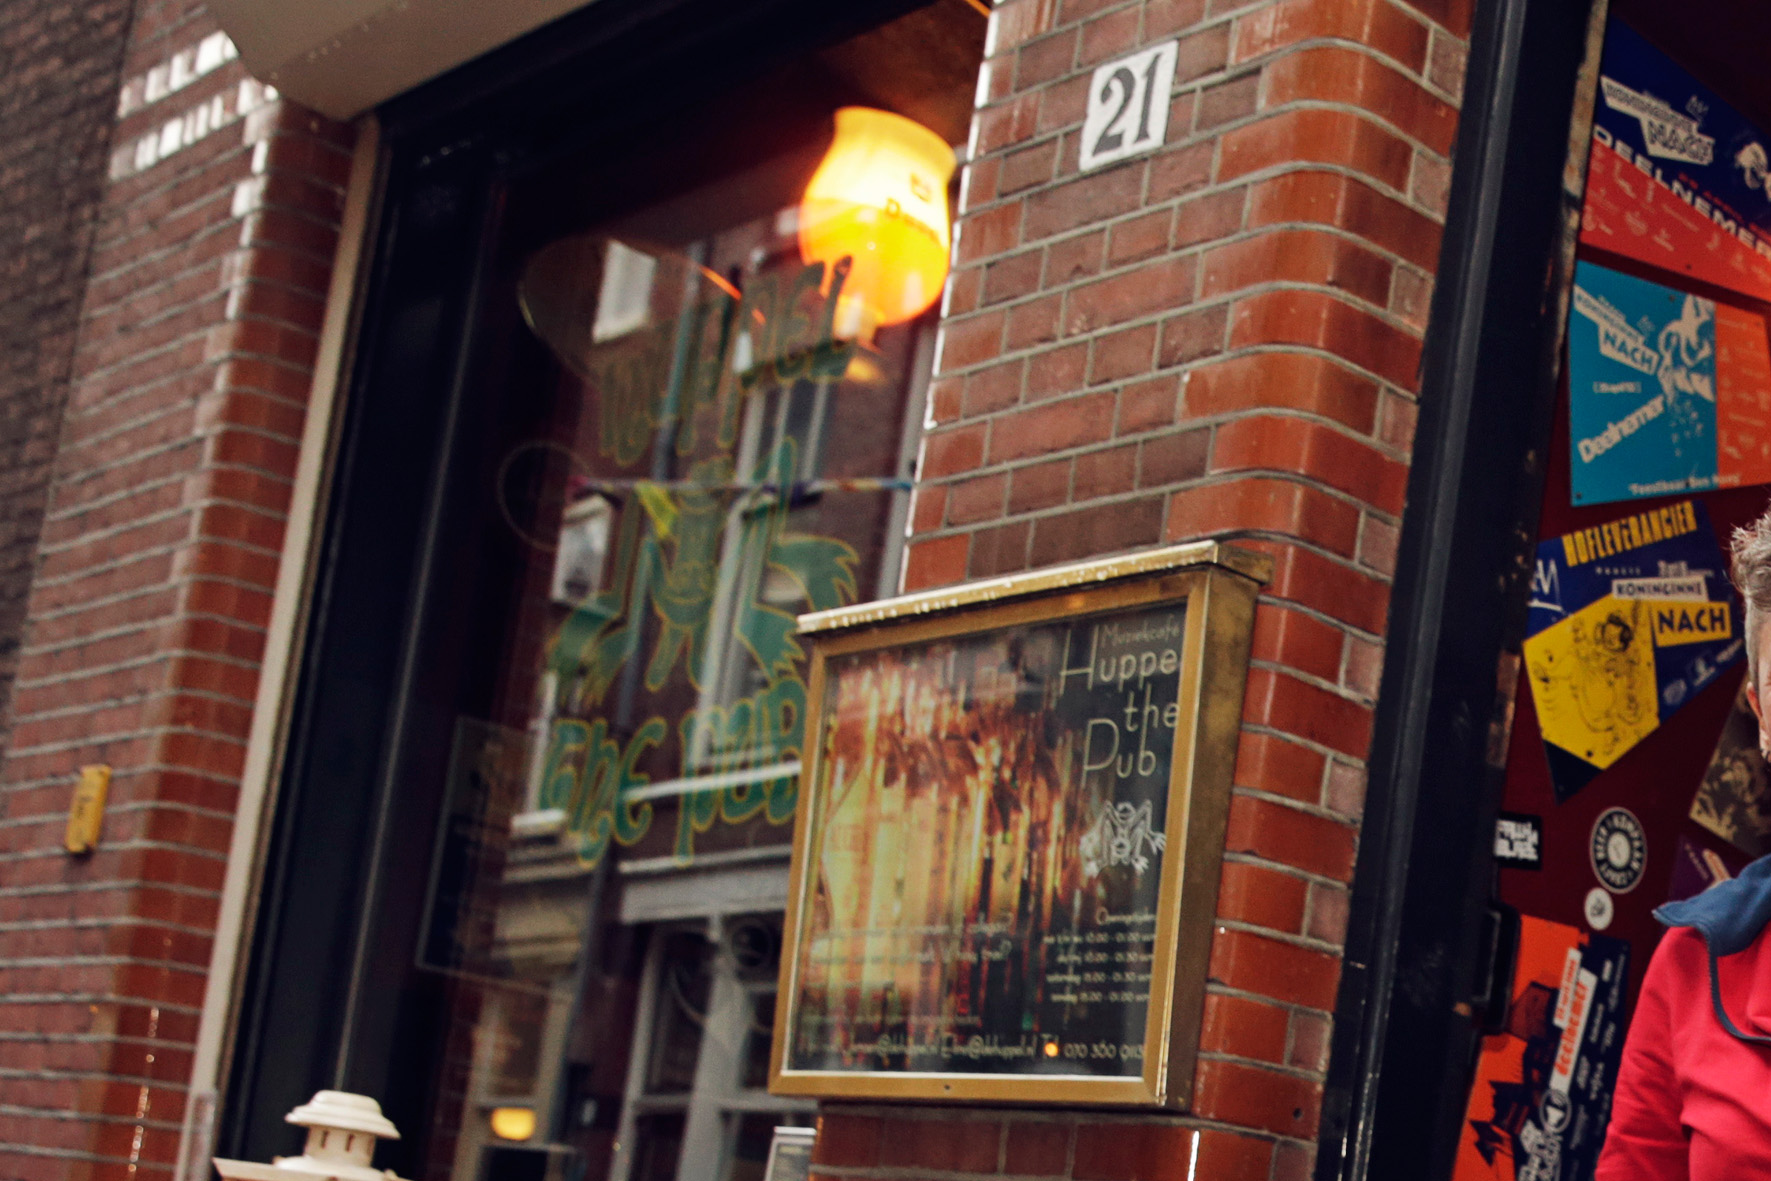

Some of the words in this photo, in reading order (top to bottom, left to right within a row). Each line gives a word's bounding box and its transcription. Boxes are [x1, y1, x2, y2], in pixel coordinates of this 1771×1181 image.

[1092, 52, 1163, 157] 21
[1657, 607, 1727, 635] NACH
[1124, 683, 1180, 734] the
[1081, 717, 1157, 790] Pub
